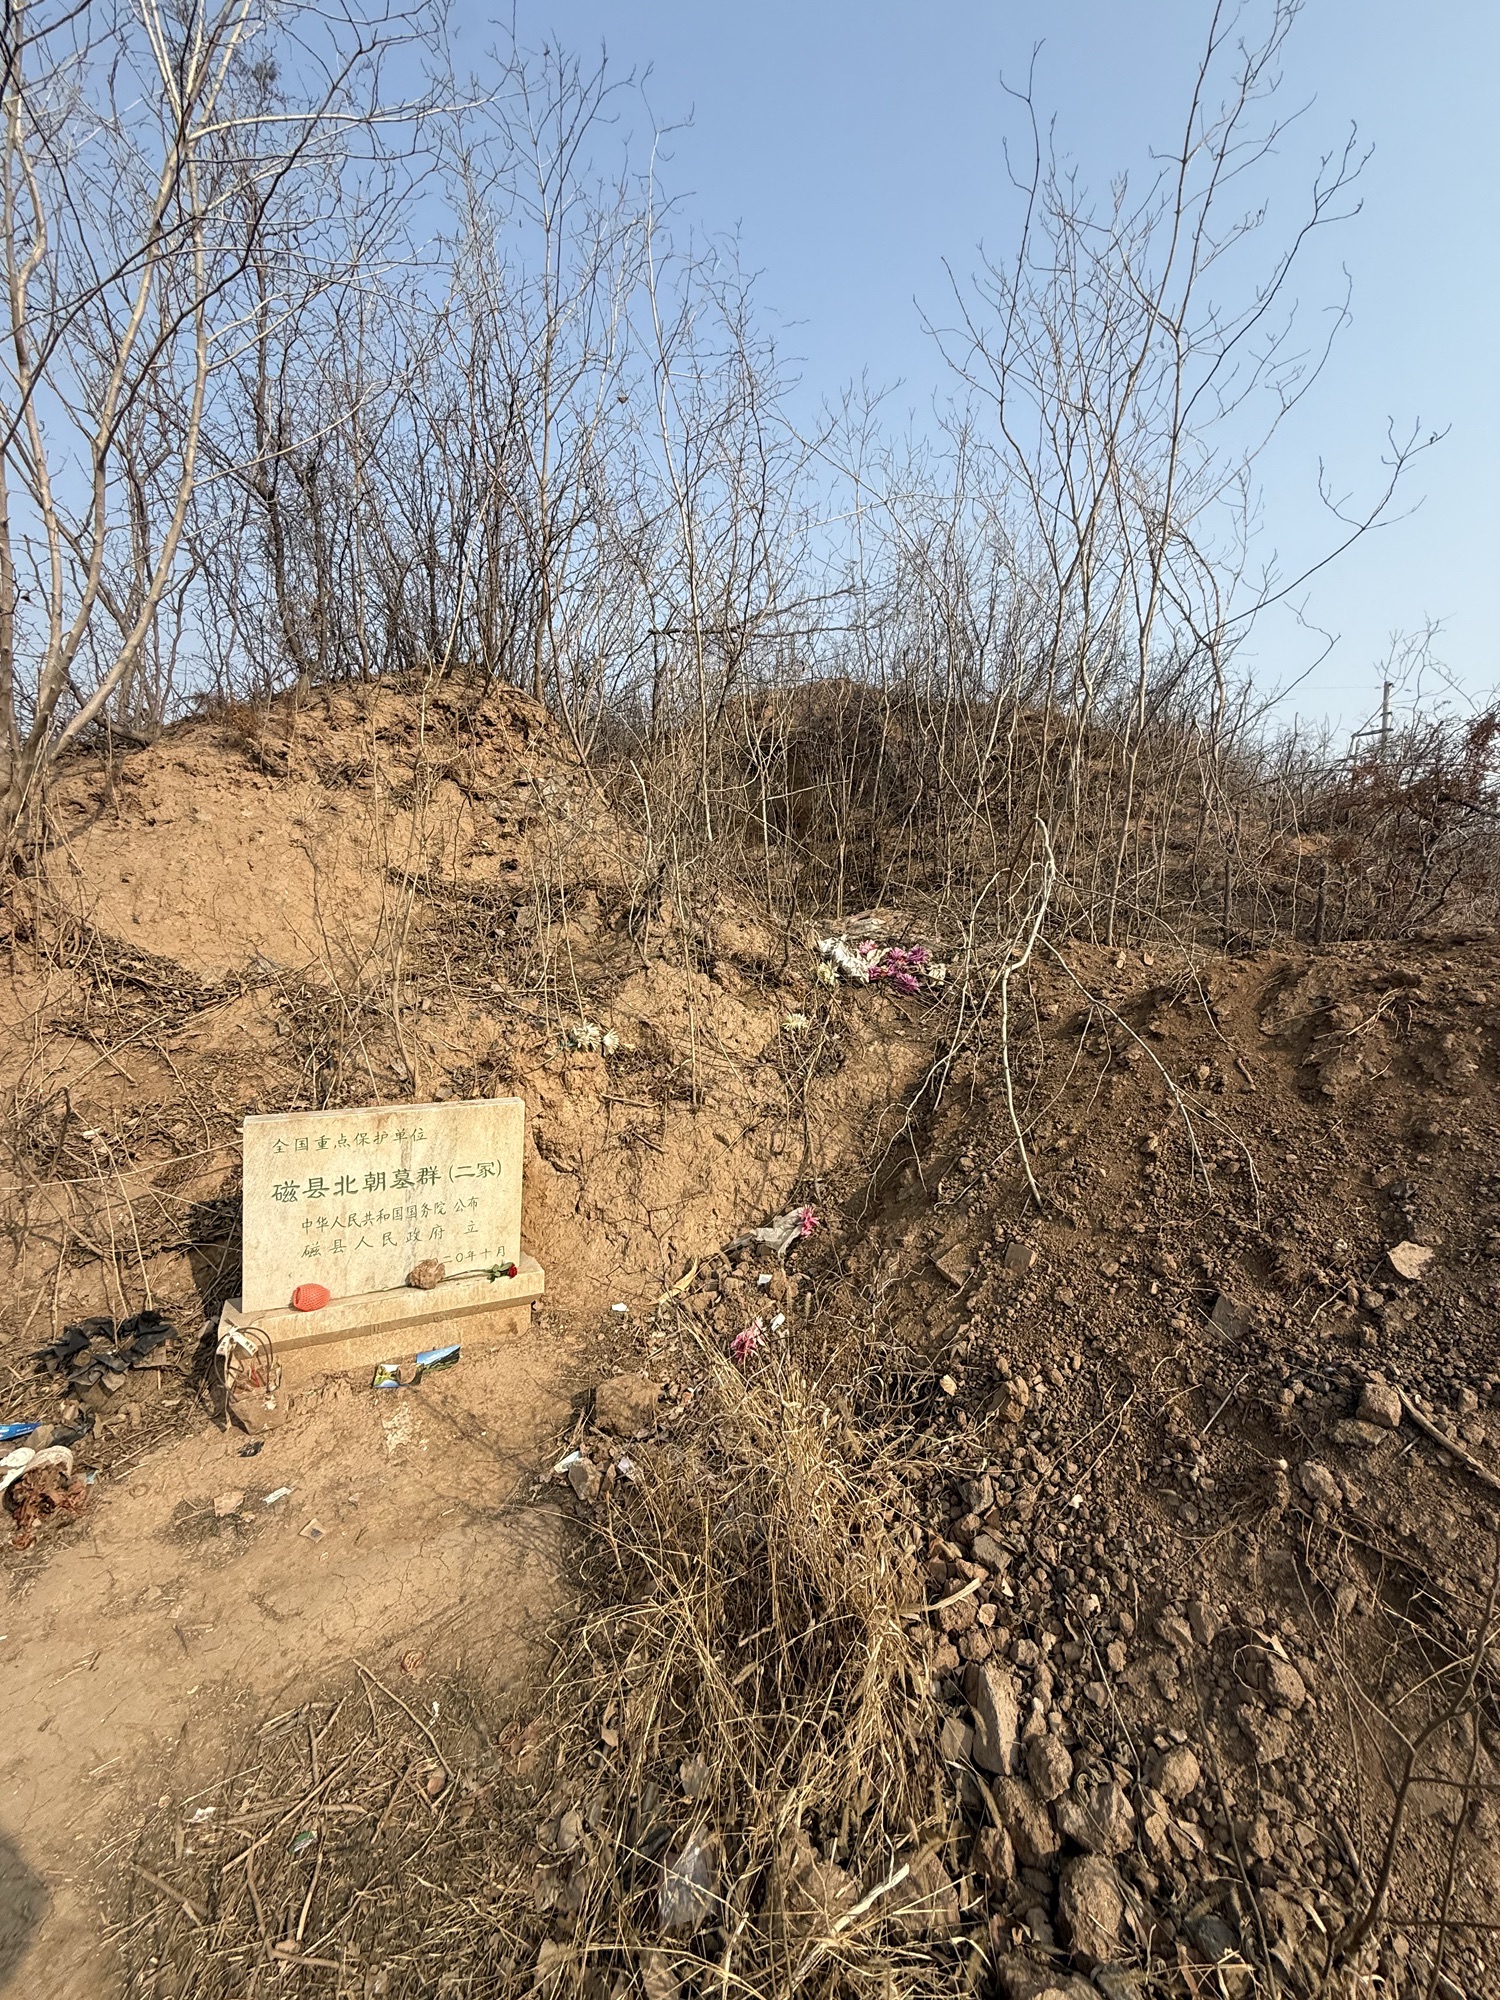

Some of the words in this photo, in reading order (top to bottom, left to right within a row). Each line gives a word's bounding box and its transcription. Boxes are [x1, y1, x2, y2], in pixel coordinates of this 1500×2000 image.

[272, 1128, 427, 1154] 全国重点保护单位
